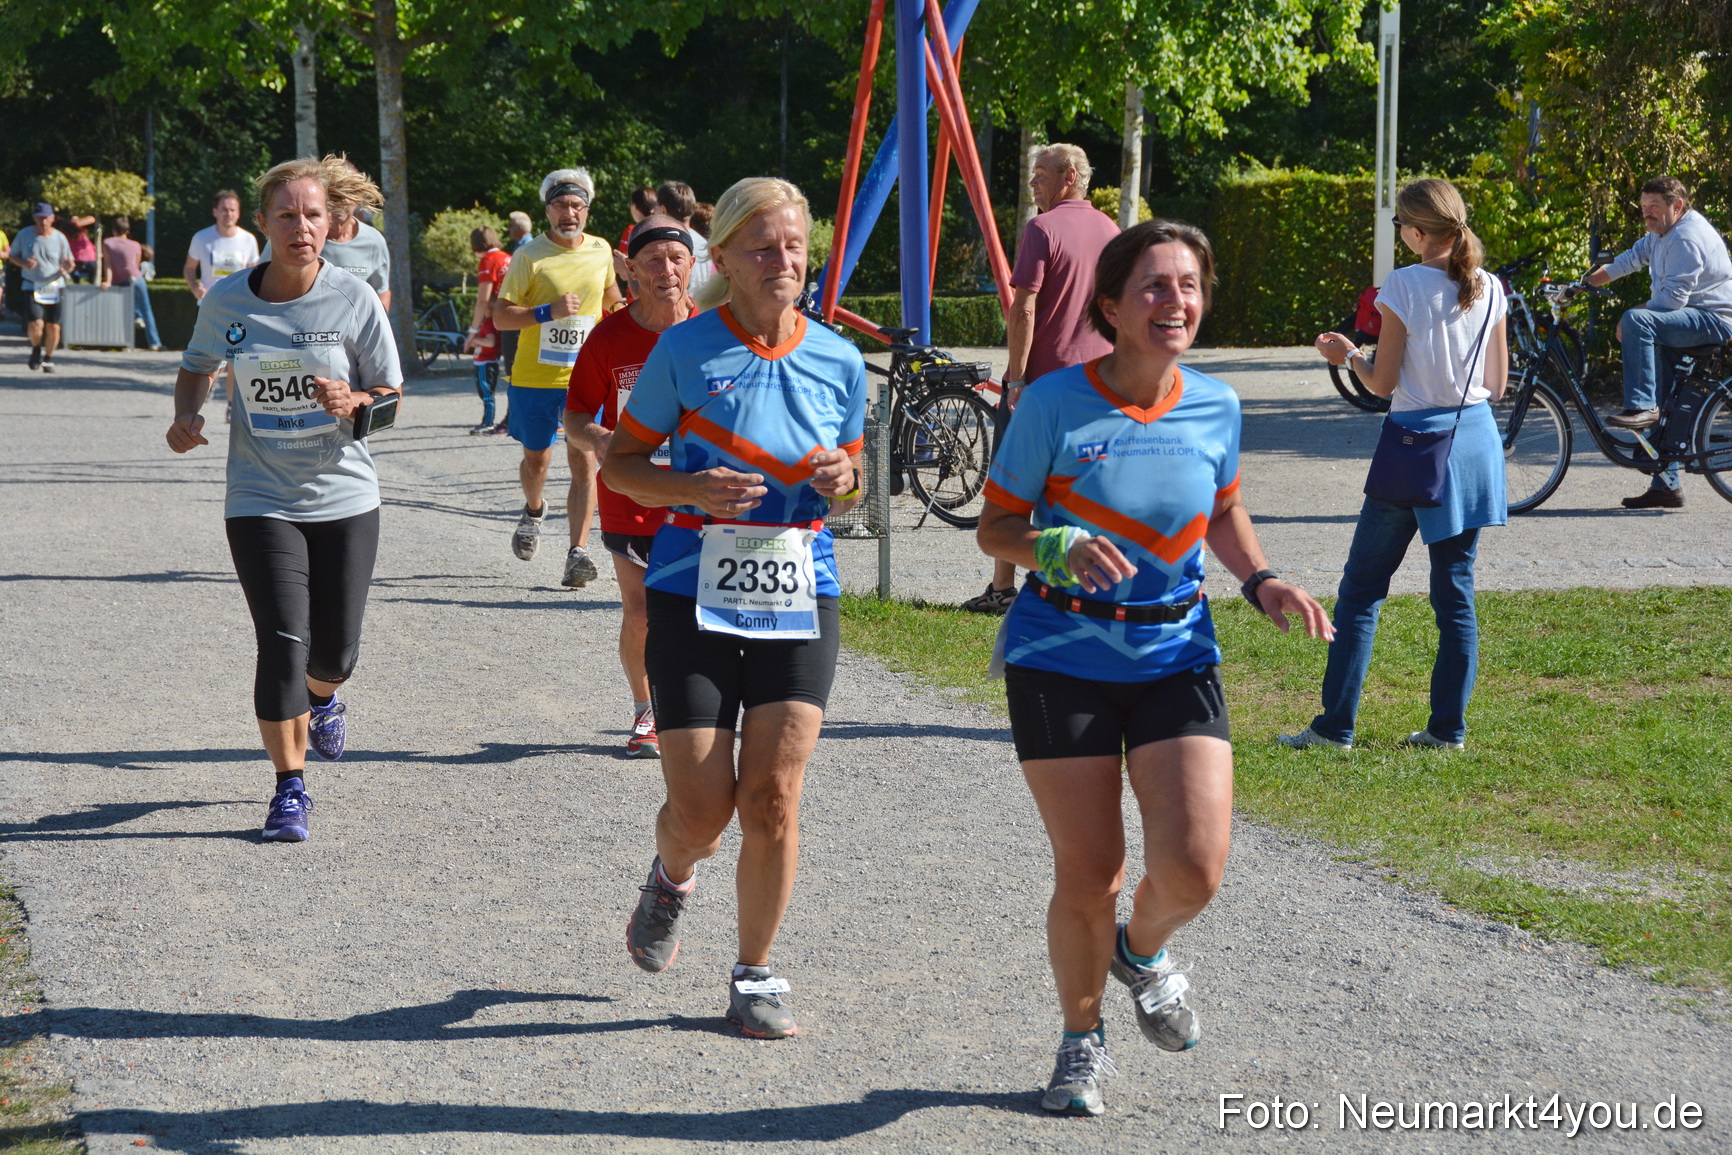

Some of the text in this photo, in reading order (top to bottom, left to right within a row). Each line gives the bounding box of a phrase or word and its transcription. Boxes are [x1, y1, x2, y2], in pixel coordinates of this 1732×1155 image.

[292, 331, 340, 344] BOCK
[549, 328, 585, 345] 3031
[260, 359, 301, 371] BOCK
[619, 369, 641, 379] IMME
[250, 374, 319, 404] 2546
[739, 381, 781, 391] Neumarkt
[277, 417, 305, 429] Anke
[276, 436, 324, 450] Stadtlauf
[1113, 436, 1183, 447] Raiffeisenbank
[1113, 446, 1160, 458] Neumarkt
[735, 536, 787, 551] BOCK
[716, 557, 799, 594] 2333
[723, 596, 783, 607] PARTL Neumarkt
[735, 613, 777, 630] Conny
